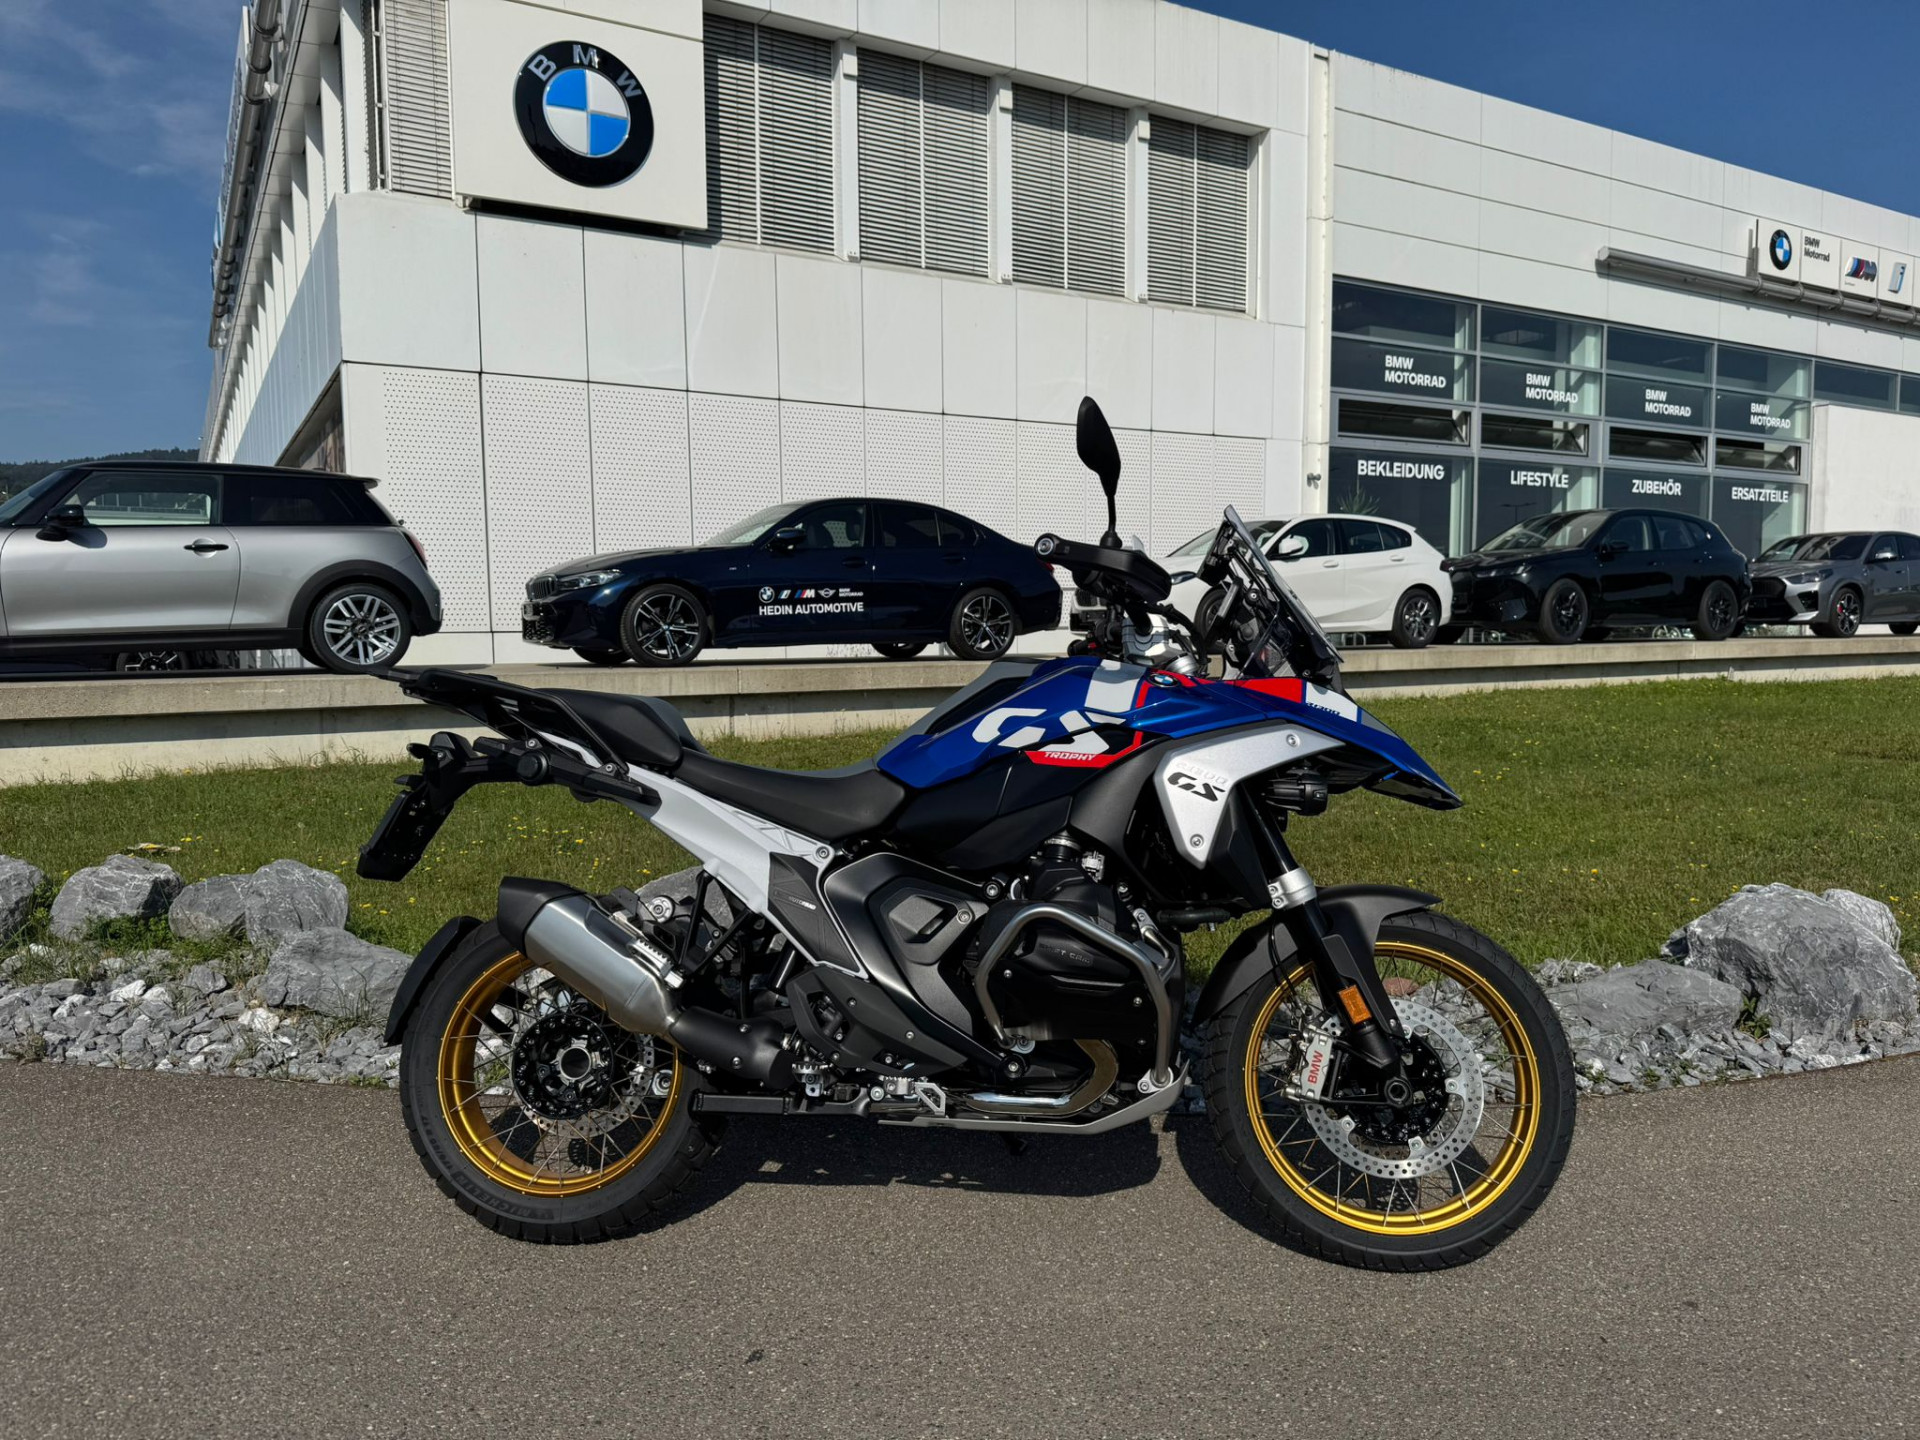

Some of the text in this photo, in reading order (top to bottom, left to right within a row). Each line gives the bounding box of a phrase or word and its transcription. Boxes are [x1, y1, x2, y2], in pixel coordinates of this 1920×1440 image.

[528, 44, 642, 98] BMW
[1804, 236, 1820, 248] BMW
[1804, 247, 1830, 262] Motorrad
[1385, 355, 1414, 370] BMW
[1384, 370, 1447, 388] MOTORRAD
[1526, 373, 1551, 387] BMW
[1525, 387, 1579, 404] MOTORRAD
[1645, 389, 1667, 402] BMW
[1645, 402, 1692, 417] MOTORRAD
[1750, 403, 1770, 415] BMW
[1750, 415, 1792, 429] MOTORRAD
[1357, 459, 1445, 480] BEKLEIDUNG
[1510, 470, 1569, 488] LIFESTYLE
[1632, 479, 1682, 496] ZUBEHÖR
[1731, 487, 1790, 503] ERSATZTEILE
[759, 602, 864, 616] HEDIN AUTOMOTIVE
[1044, 751, 1097, 761] TROPHY
[1167, 772, 1226, 802] GS
[1307, 1050, 1323, 1084] BMW
[459, 1173, 531, 1217] MICHELIN
